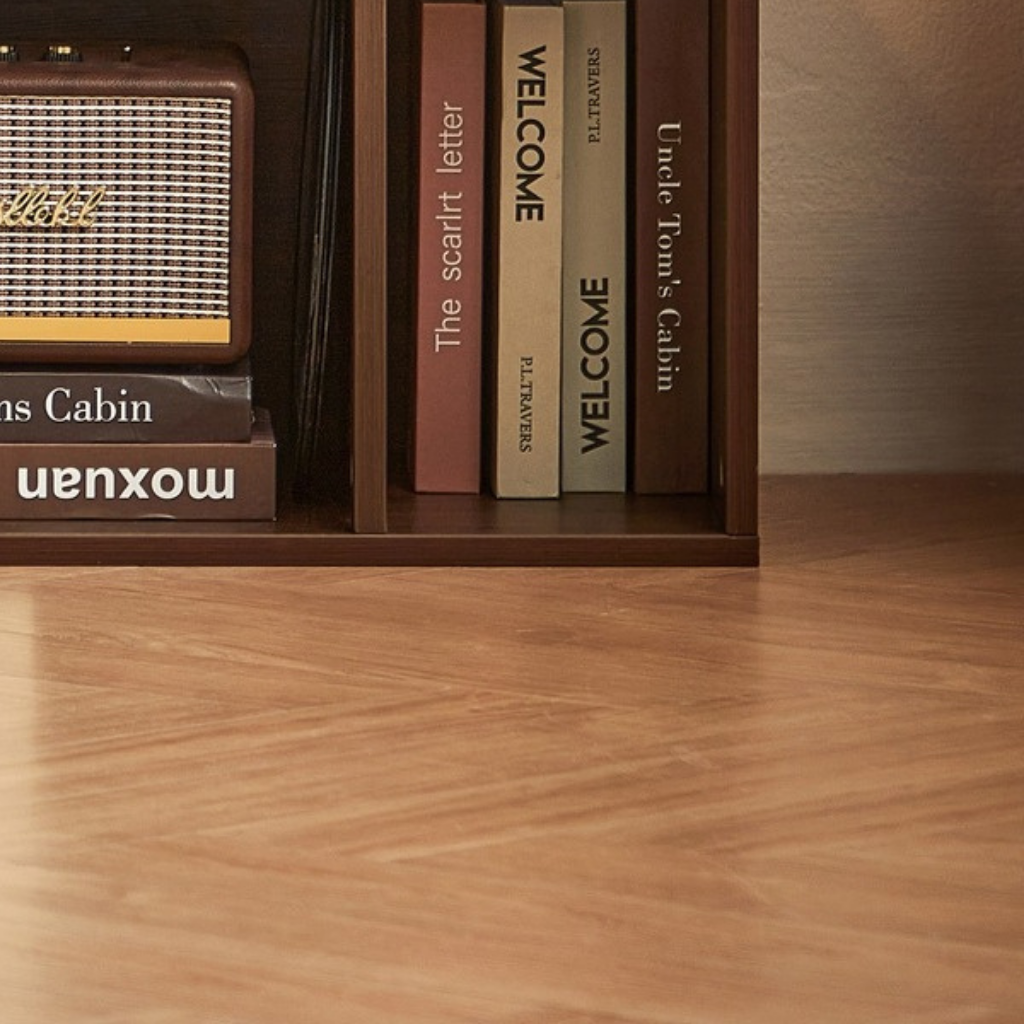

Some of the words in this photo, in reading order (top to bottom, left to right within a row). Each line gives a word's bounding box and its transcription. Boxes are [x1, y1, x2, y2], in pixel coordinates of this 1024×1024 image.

[436, 102, 463, 174] letter
[515, 45, 546, 222] WELCOME
[656, 121, 682, 205] Uncle
[656, 212, 682, 300] Tom's
[435, 296, 463, 352] The
[580, 278, 610, 454] WELCOME
[656, 308, 682, 393] Cabin
[45, 386, 153, 423] Cabin
[18, 466, 234, 500] moxuan
